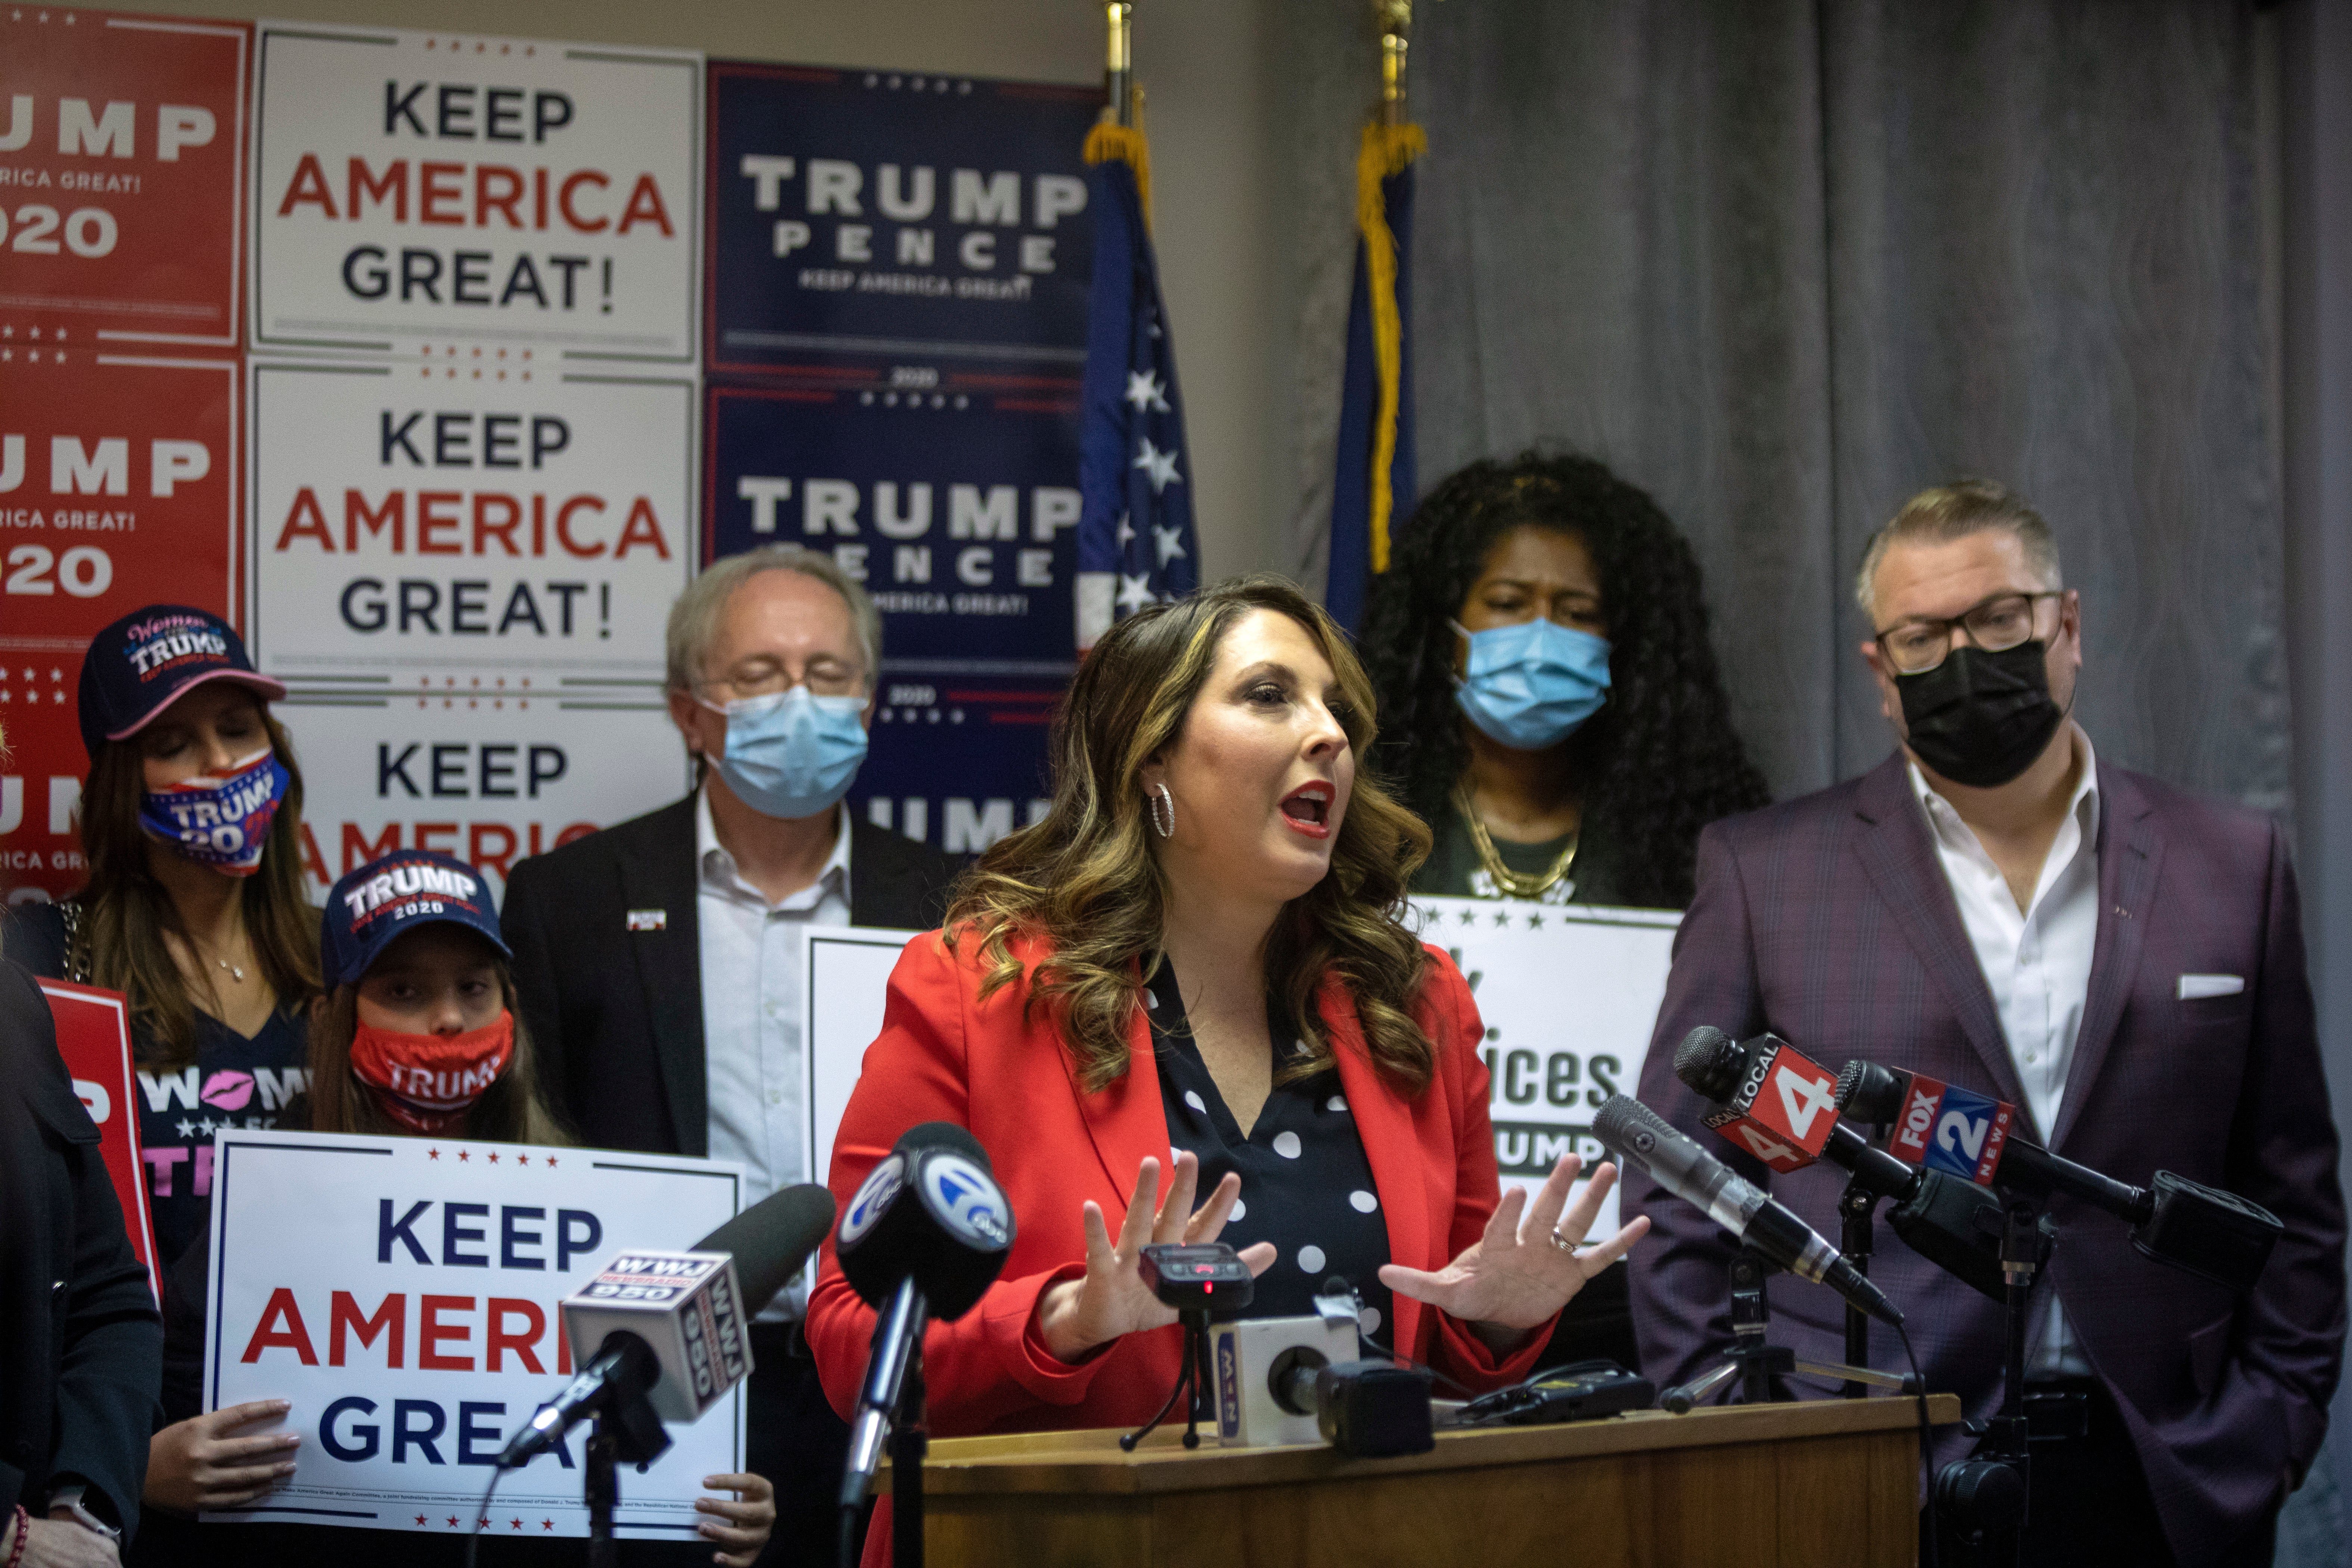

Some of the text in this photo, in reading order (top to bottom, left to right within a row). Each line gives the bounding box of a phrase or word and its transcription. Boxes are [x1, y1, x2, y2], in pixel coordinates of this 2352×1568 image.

[382, 79, 575, 144] KEEP
[60, 171, 141, 193] GREAT!
[277, 152, 675, 238] AMERICA
[739, 153, 1089, 229] TRUMP
[0, 204, 118, 258] 20
[771, 221, 1057, 273] PENCE
[341, 244, 613, 314] GREAT!
[379, 410, 571, 470] KEEP
[54, 511, 135, 532] GREAT!
[276, 487, 671, 560] AMERICA
[737, 476, 1083, 542] TRUMP
[0, 544, 113, 598] 20
[773, 542, 1054, 587] ENCE
[340, 578, 612, 639] GREAT!
[129, 632, 227, 675] TRUMP
[377, 743, 568, 798] KEEP
[170, 772, 274, 829] TRUMP
[344, 864, 478, 920] TRUMP
[393, 900, 444, 921] 2020
[388, 1054, 501, 1099] TRUMP
[1739, 1045, 1778, 1108] LOCAL
[1775, 1065, 1835, 1140] 4
[1704, 1108, 1741, 1128] LOCAL
[1739, 1124, 1800, 1161] 4
[1900, 1089, 1939, 1149] FOX
[1937, 1110, 1989, 1161] 2
[1980, 1113, 2008, 1176] NEWS
[377, 1198, 603, 1272] KEEP
[592, 1285, 673, 1300] 950
[617, 1259, 711, 1277] WWJ
[712, 1275, 744, 1378] WWJ
